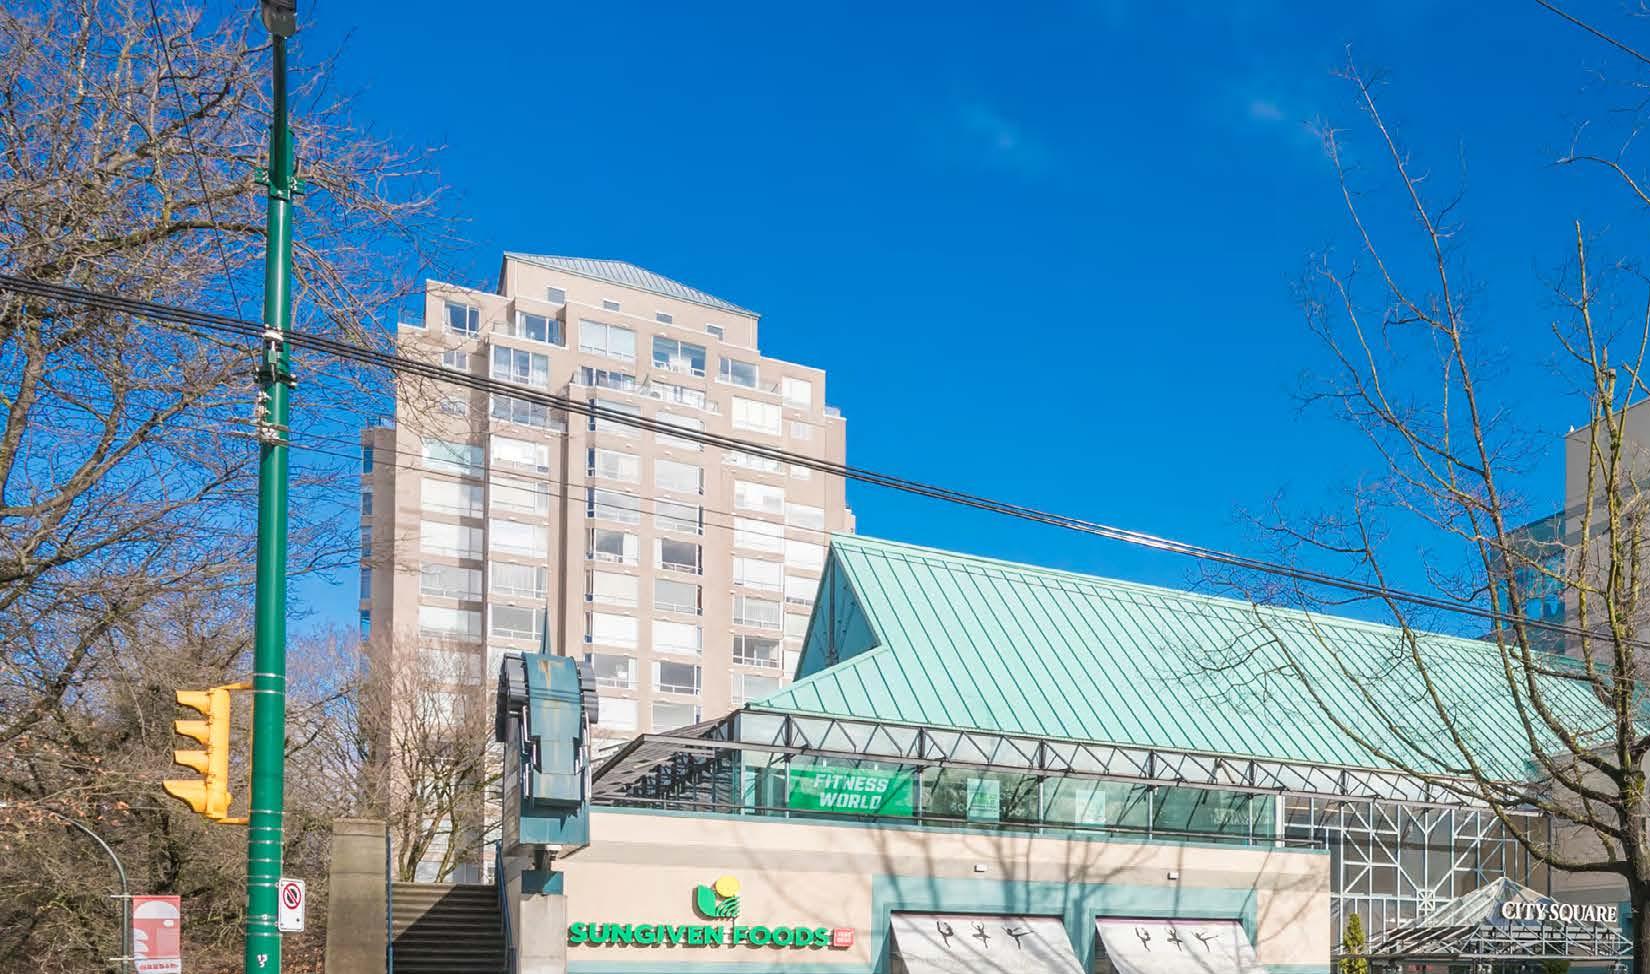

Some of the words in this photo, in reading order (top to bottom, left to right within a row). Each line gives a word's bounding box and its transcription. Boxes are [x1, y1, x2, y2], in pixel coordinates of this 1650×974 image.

[813, 773, 889, 792] FITNESS
[819, 792, 883, 810] WORLD
[1502, 901, 1548, 920] CITY
[1549, 903, 1617, 923] SQUARE
[569, 921, 724, 945] SUNGIVEN
[732, 925, 829, 947] FOODS
